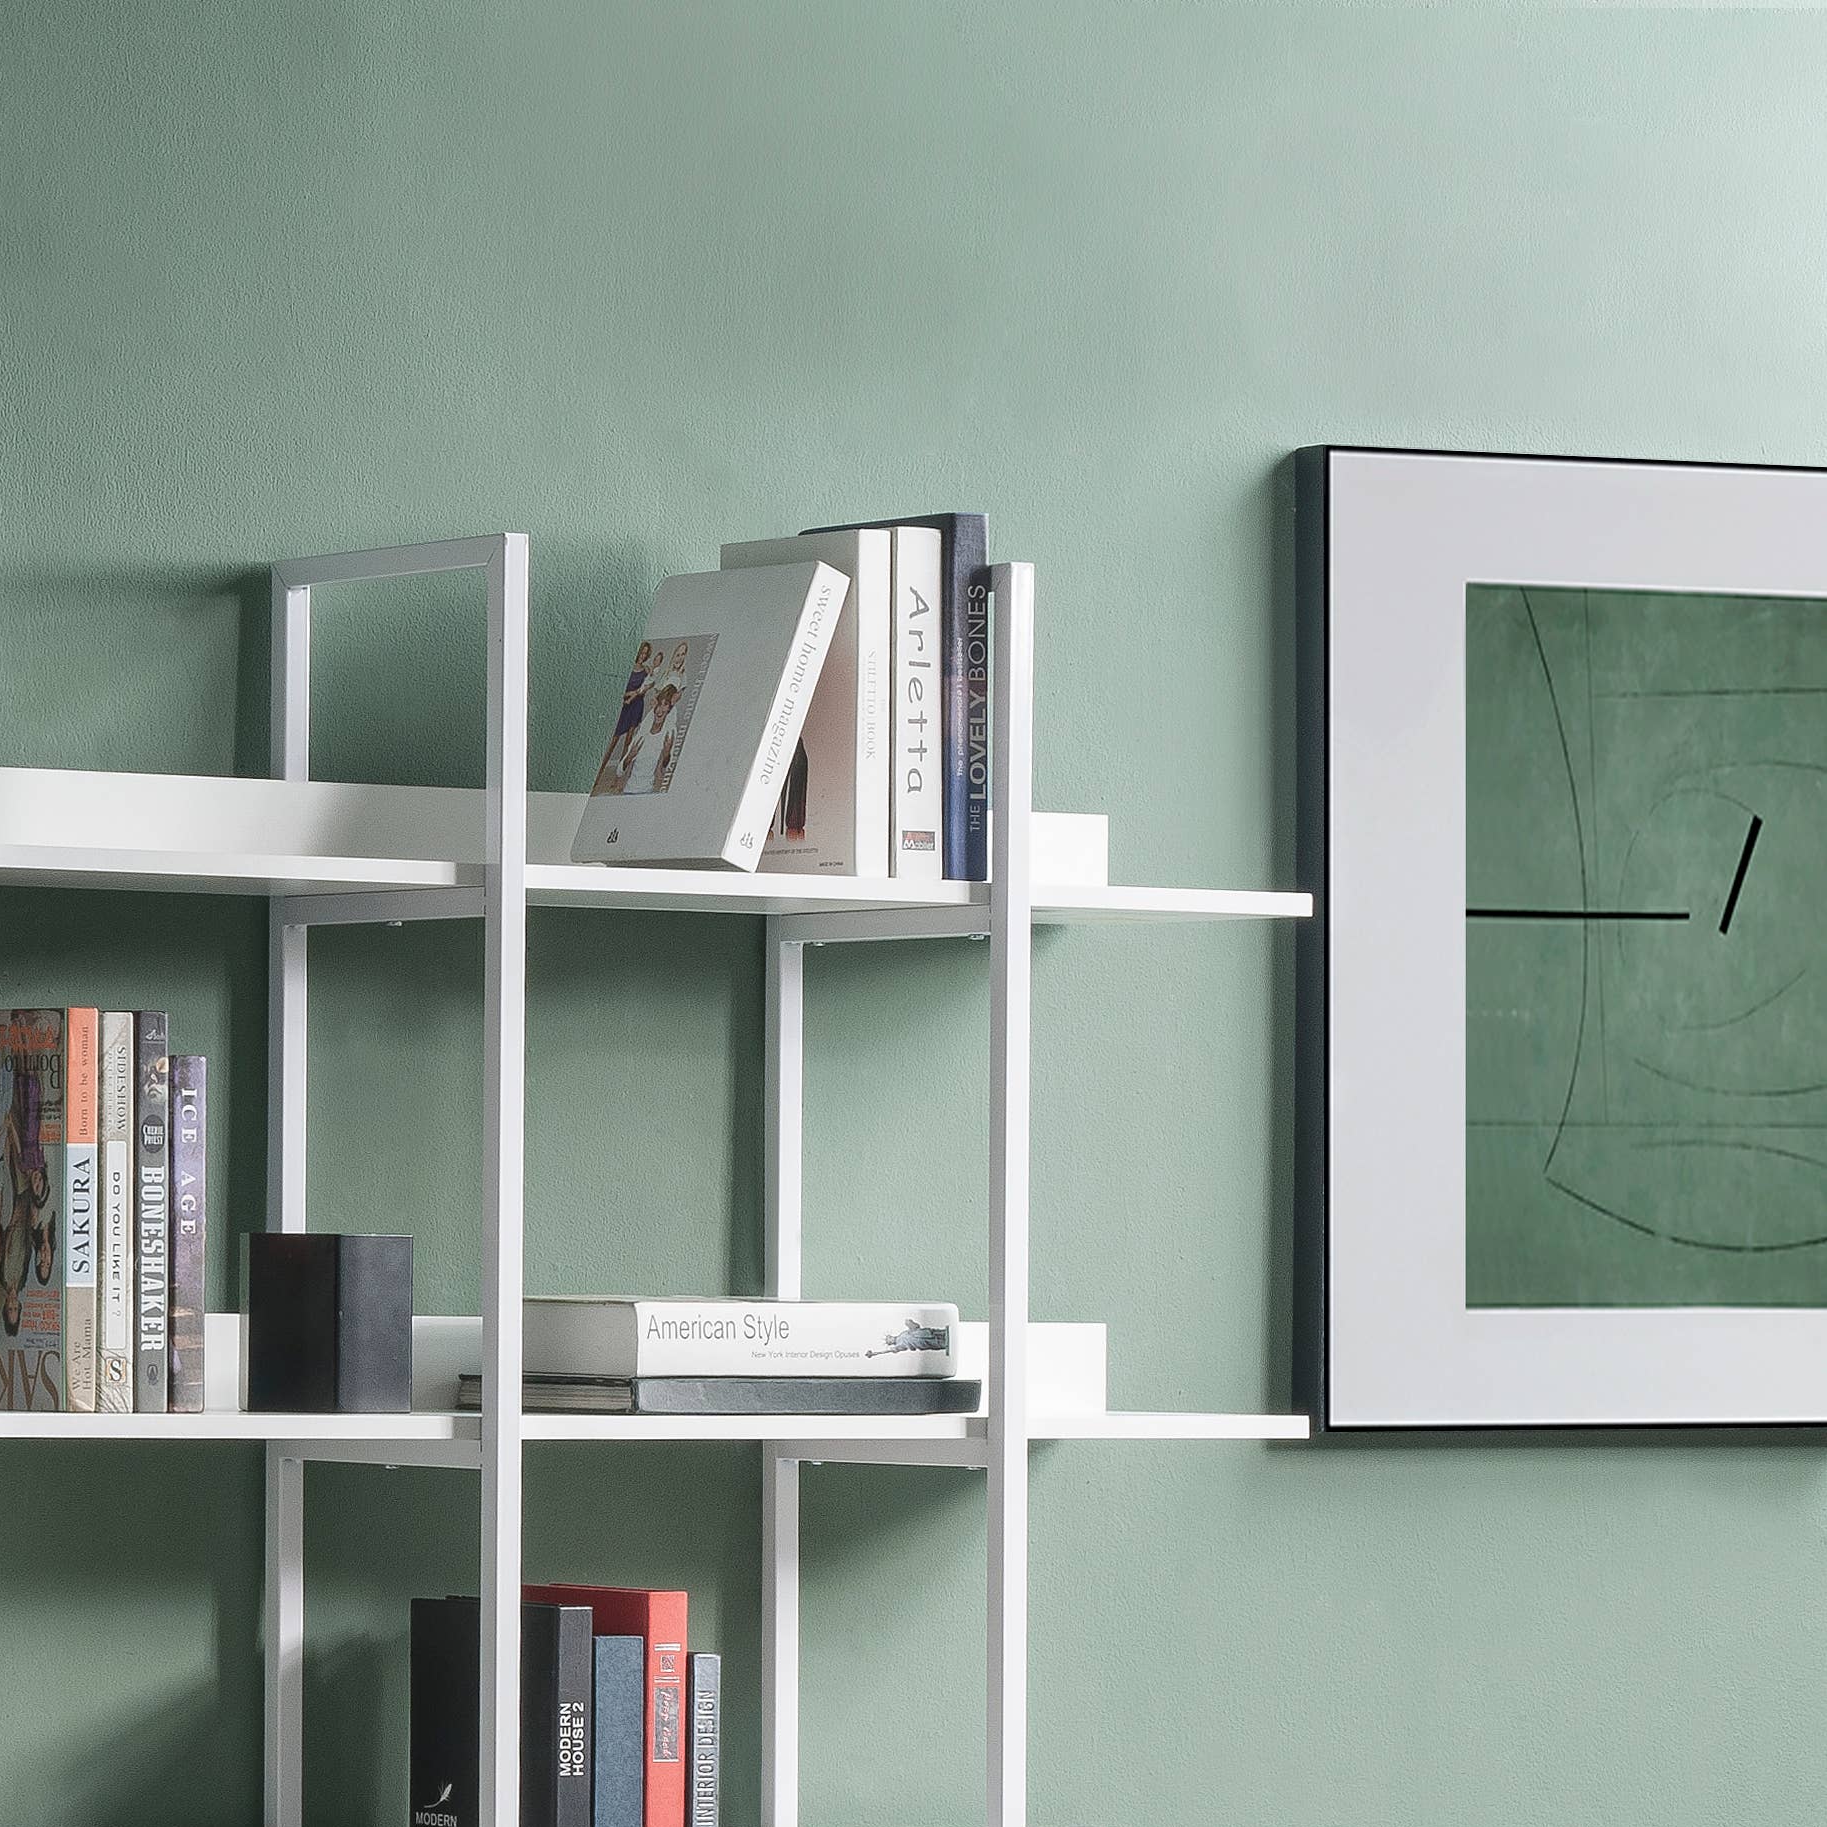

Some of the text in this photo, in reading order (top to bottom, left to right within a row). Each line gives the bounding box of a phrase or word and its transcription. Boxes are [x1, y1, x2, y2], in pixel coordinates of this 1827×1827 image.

[682, 677, 706, 722] home
[760, 584, 832, 786] sweet home magazine
[907, 586, 931, 793] Arletta
[968, 585, 986, 832] THE LOVELY BONES
[79, 1026, 89, 1136] Born to be woman
[117, 1045, 127, 1132] SIDESHOW
[113, 1172, 120, 1195] DO
[180, 1088, 197, 1235] ICE AGE
[72, 1158, 90, 1274] SAKURA
[112, 1203, 120, 1237] YOU
[112, 1243, 120, 1281] LIKE
[112, 1287, 120, 1302] IT
[141, 1166, 165, 1351] BONESHAKER
[83, 1319, 92, 1390] Hot Mama
[647, 1313, 790, 1346] American Style
[810, 1351, 833, 1360] Design
[72, 1342, 81, 1391] We Are
[560, 1703, 572, 1776] MODERN
[572, 1702, 585, 1776] HOUSE 2
[697, 1690, 715, 1749] DESIGN
[415, 1812, 458, 1827] MODERN
[696, 1753, 715, 1826] INTERIOR
